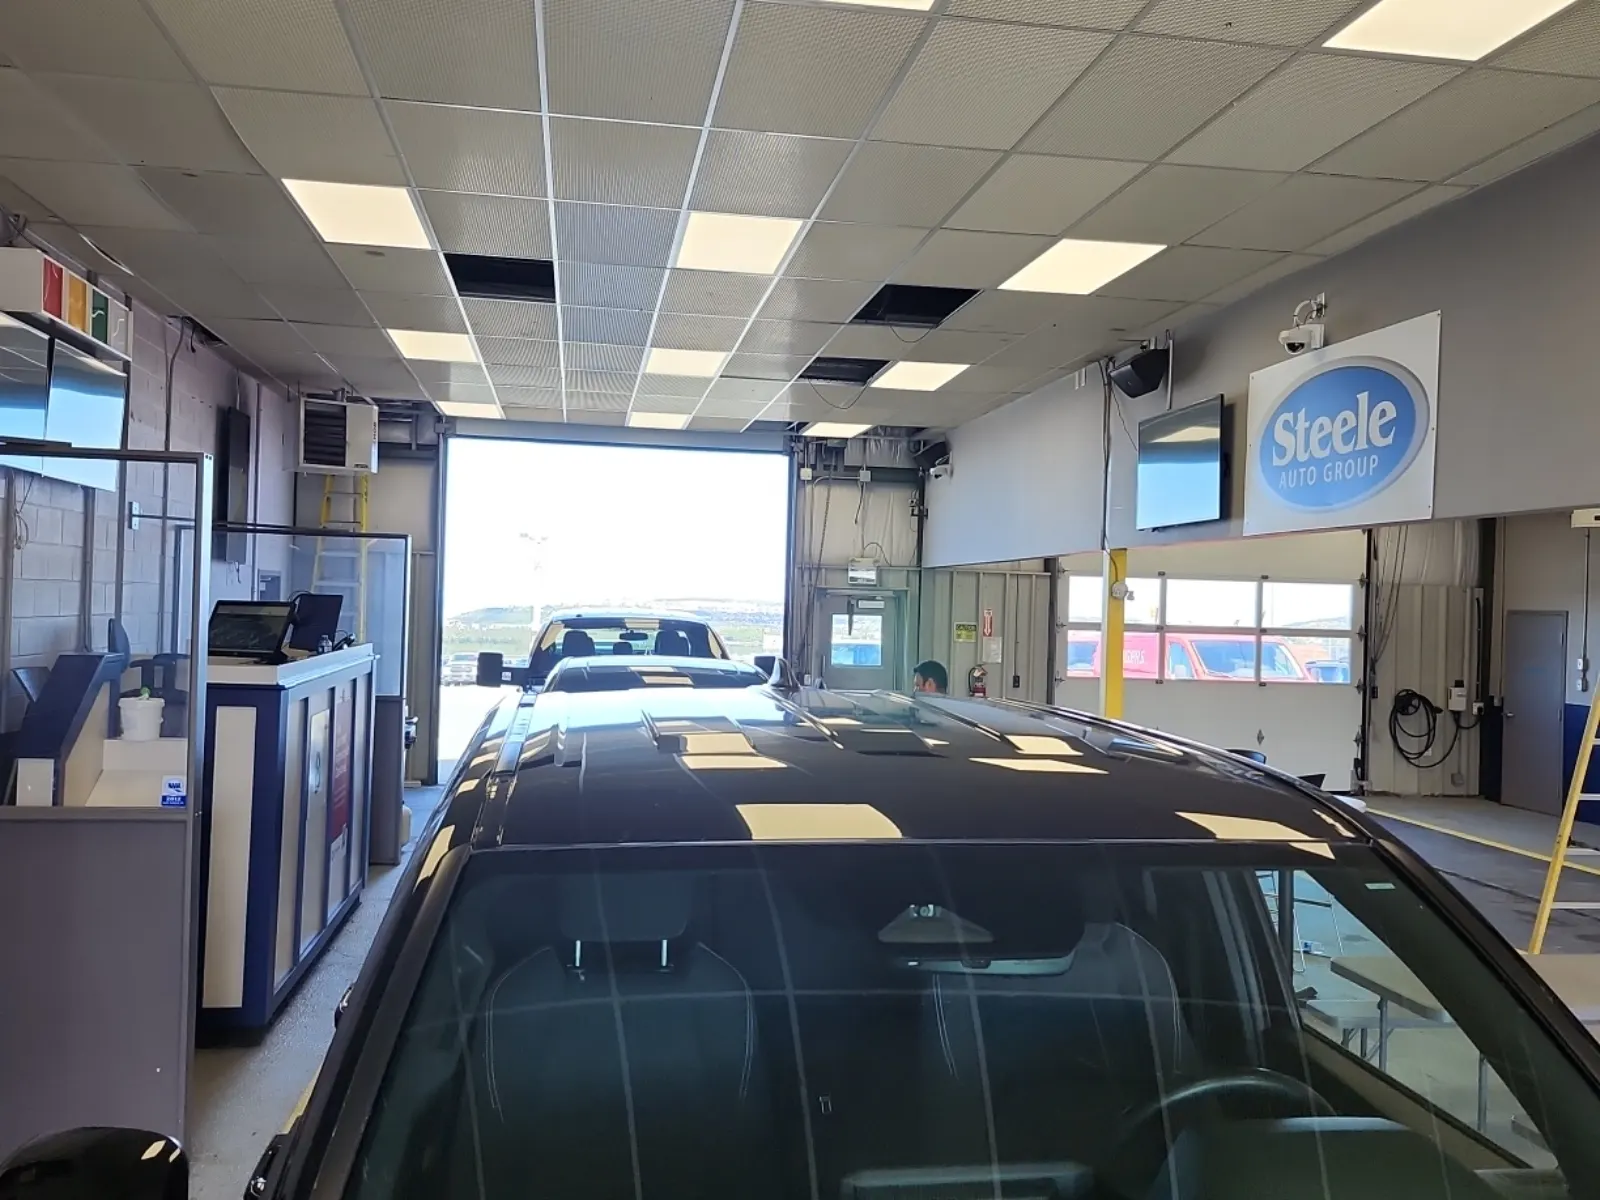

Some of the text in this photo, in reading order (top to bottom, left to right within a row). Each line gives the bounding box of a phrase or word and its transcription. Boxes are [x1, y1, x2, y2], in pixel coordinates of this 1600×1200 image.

[1273, 391, 1396, 466] Steele
[1279, 455, 1378, 489] AUTO GROUP
